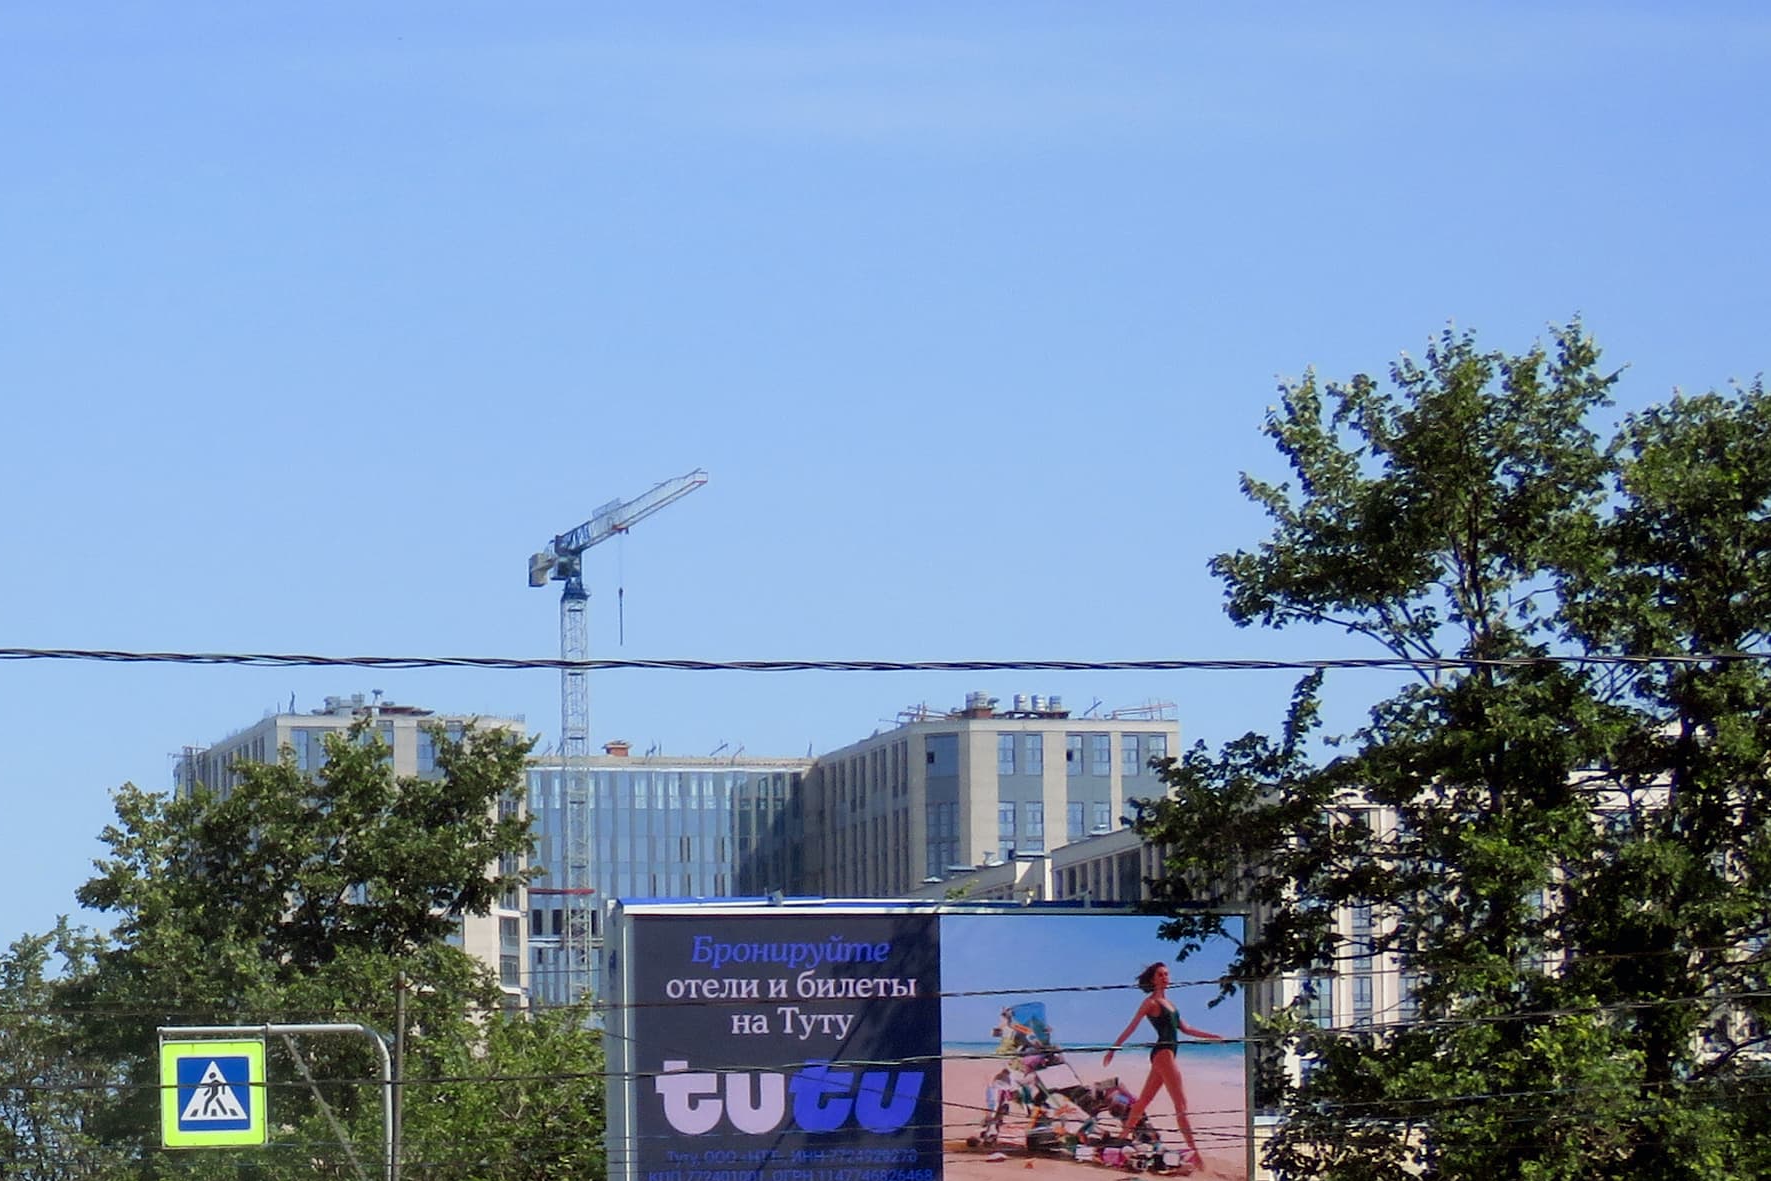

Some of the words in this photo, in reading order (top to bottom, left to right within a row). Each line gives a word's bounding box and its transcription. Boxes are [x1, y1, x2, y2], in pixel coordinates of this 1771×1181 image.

[691, 934, 892, 969] Бронируйте
[665, 978, 760, 999] отели
[768, 978, 789, 999] и
[796, 969, 918, 999] билеты
[731, 1013, 770, 1035] на
[777, 1006, 855, 1041] Туту
